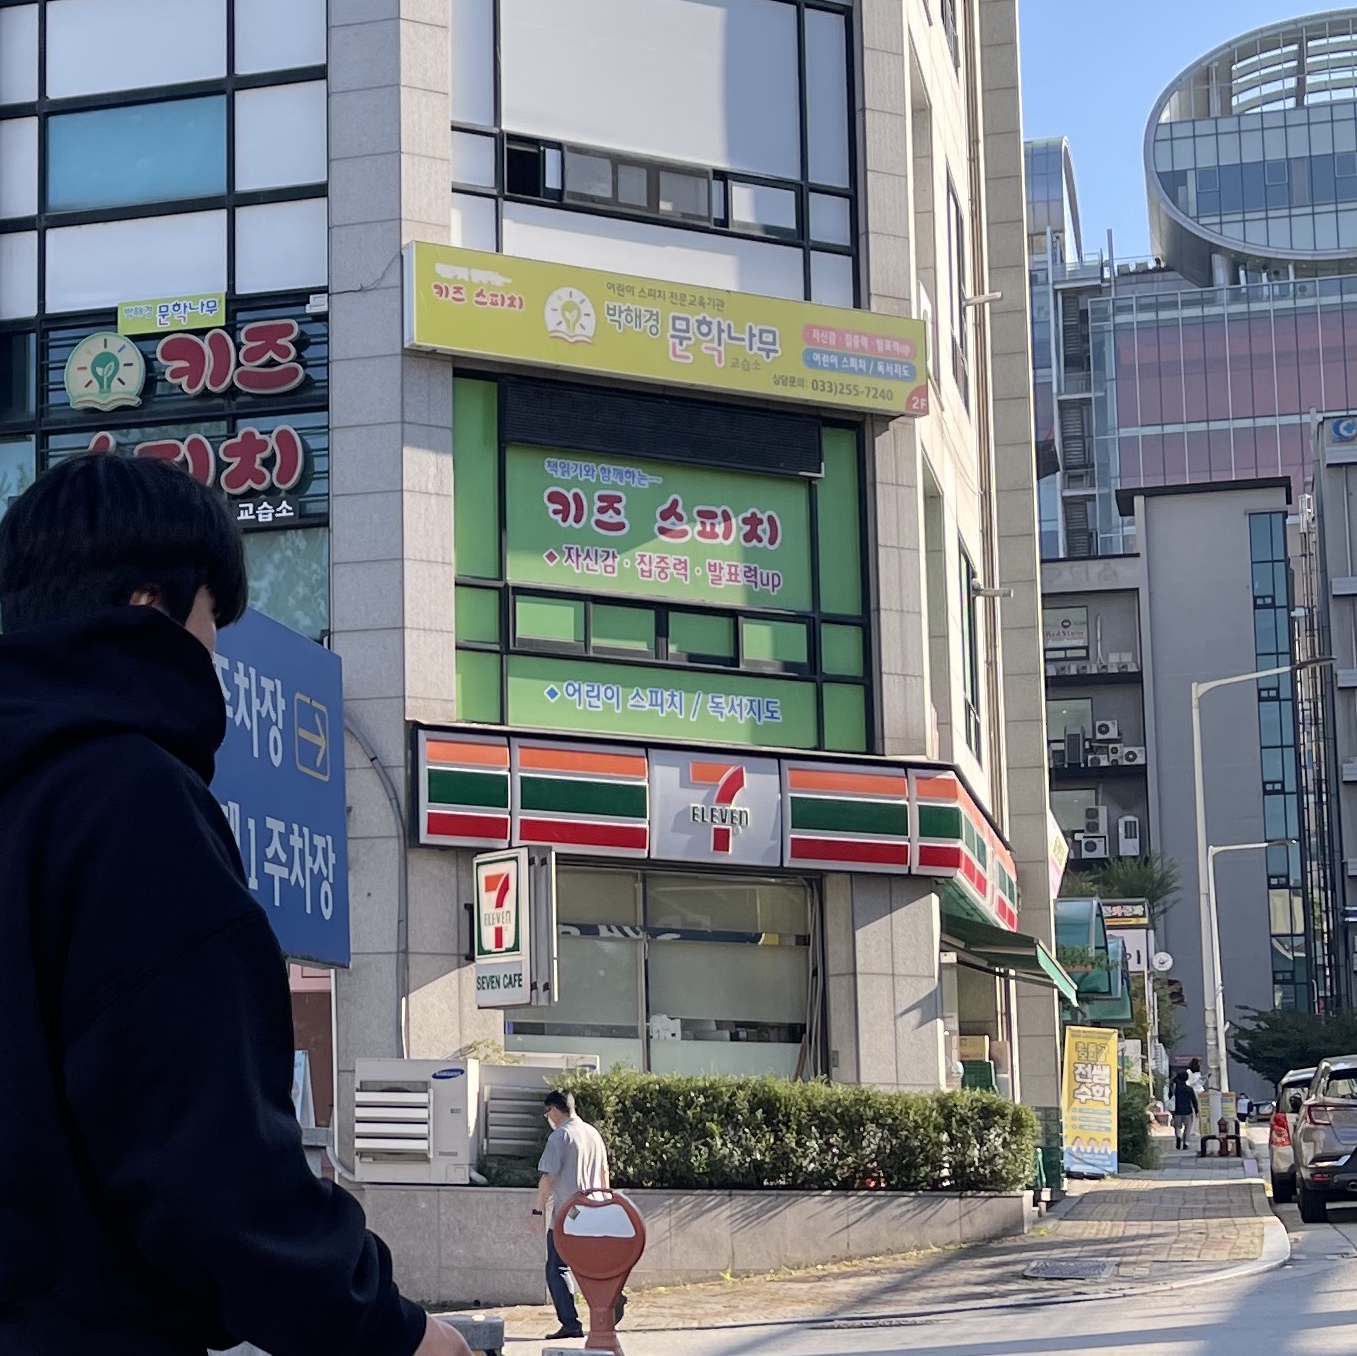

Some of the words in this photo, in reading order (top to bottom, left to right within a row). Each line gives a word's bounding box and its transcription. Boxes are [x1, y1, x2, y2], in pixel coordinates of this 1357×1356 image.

[432, 283, 466, 303] 키즈
[474, 287, 524, 312] 스피치
[606, 281, 635, 297] 어린이
[157, 300, 219, 327] 문학나무
[605, 302, 661, 338] 박해경
[667, 313, 782, 368] 문학나무
[156, 319, 305, 395] 키즈
[812, 352, 839, 369] 어린이
[811, 379, 894, 401] 033)255-7240
[911, 396, 927, 410] 2F
[87, 425, 304, 495] 피치
[545, 458, 596, 481] 책읽기와
[236, 501, 295, 522] 교습소
[545, 487, 629, 534] 키즈
[656, 494, 782, 549] 스피치
[563, 546, 618, 575] 자신감
[636, 553, 690, 583] 집중력
[706, 560, 783, 595] 발표력up
[564, 680, 622, 712] 어린이
[628, 687, 685, 718] 스피치
[708, 693, 783, 724] 독서지도
[476, 974, 501, 991] SEVEN
[503, 972, 523, 989] CAFE
